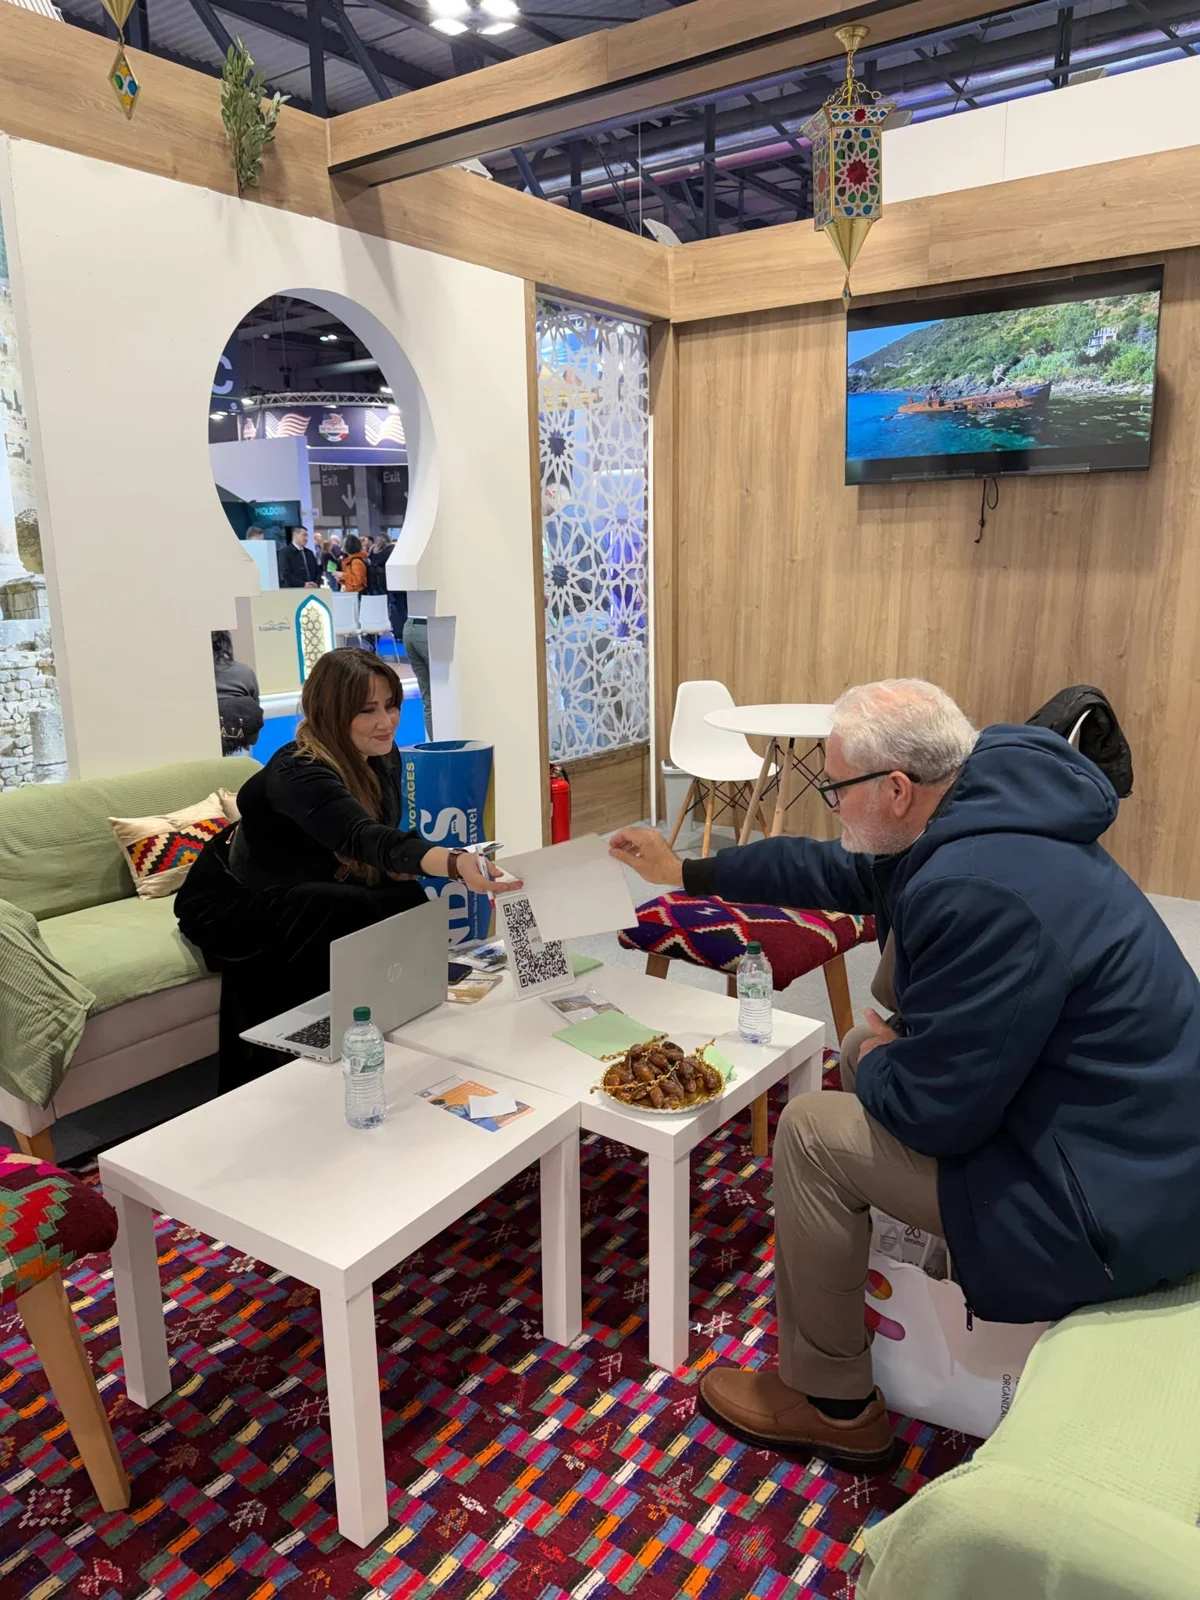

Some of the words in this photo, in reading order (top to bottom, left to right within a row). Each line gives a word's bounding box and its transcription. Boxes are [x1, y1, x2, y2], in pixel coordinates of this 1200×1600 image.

[321, 474, 339, 487] Exit
[383, 470, 401, 484] Exit
[255, 506, 288, 517] MOLDOVA
[405, 762, 417, 830] VOYAGES
[1000, 1373, 1012, 1421] ORGANIZA
